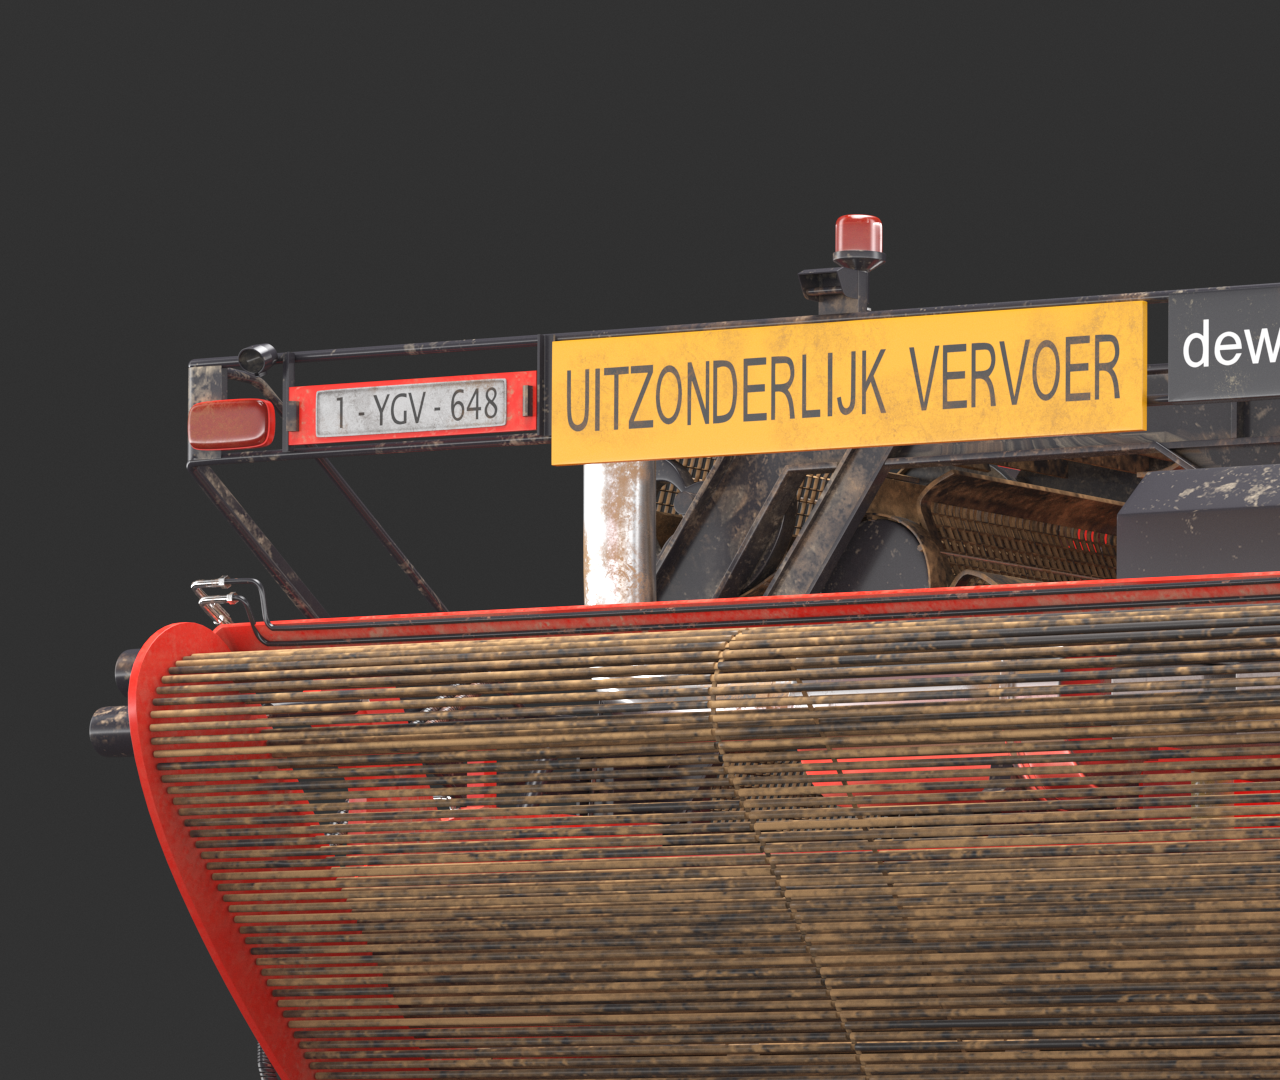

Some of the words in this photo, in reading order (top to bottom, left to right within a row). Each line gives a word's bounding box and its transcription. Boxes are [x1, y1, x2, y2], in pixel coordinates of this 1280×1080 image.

[336, 397, 343, 429] 1
[373, 391, 427, 426] YGV
[450, 387, 498, 421] 648
[566, 348, 888, 432] UITZONDERLIJK
[908, 334, 1122, 411] VERVOER
